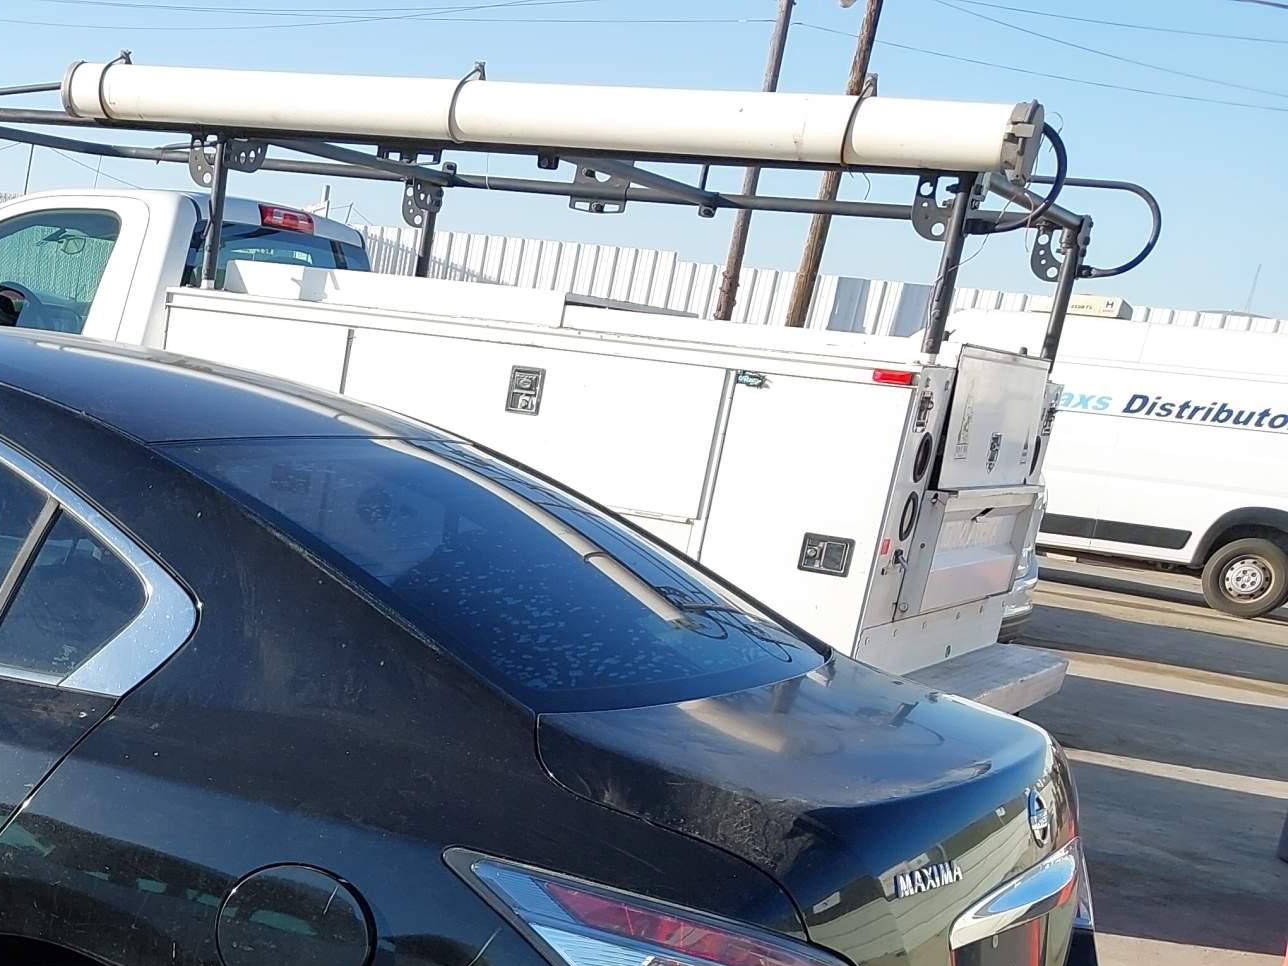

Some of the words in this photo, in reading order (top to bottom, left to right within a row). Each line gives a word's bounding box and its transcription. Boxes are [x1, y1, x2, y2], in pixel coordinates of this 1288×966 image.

[1061, 391, 1113, 411] axs
[1121, 393, 1288, 429] Distributo
[896, 861, 963, 898] MAXIMA
